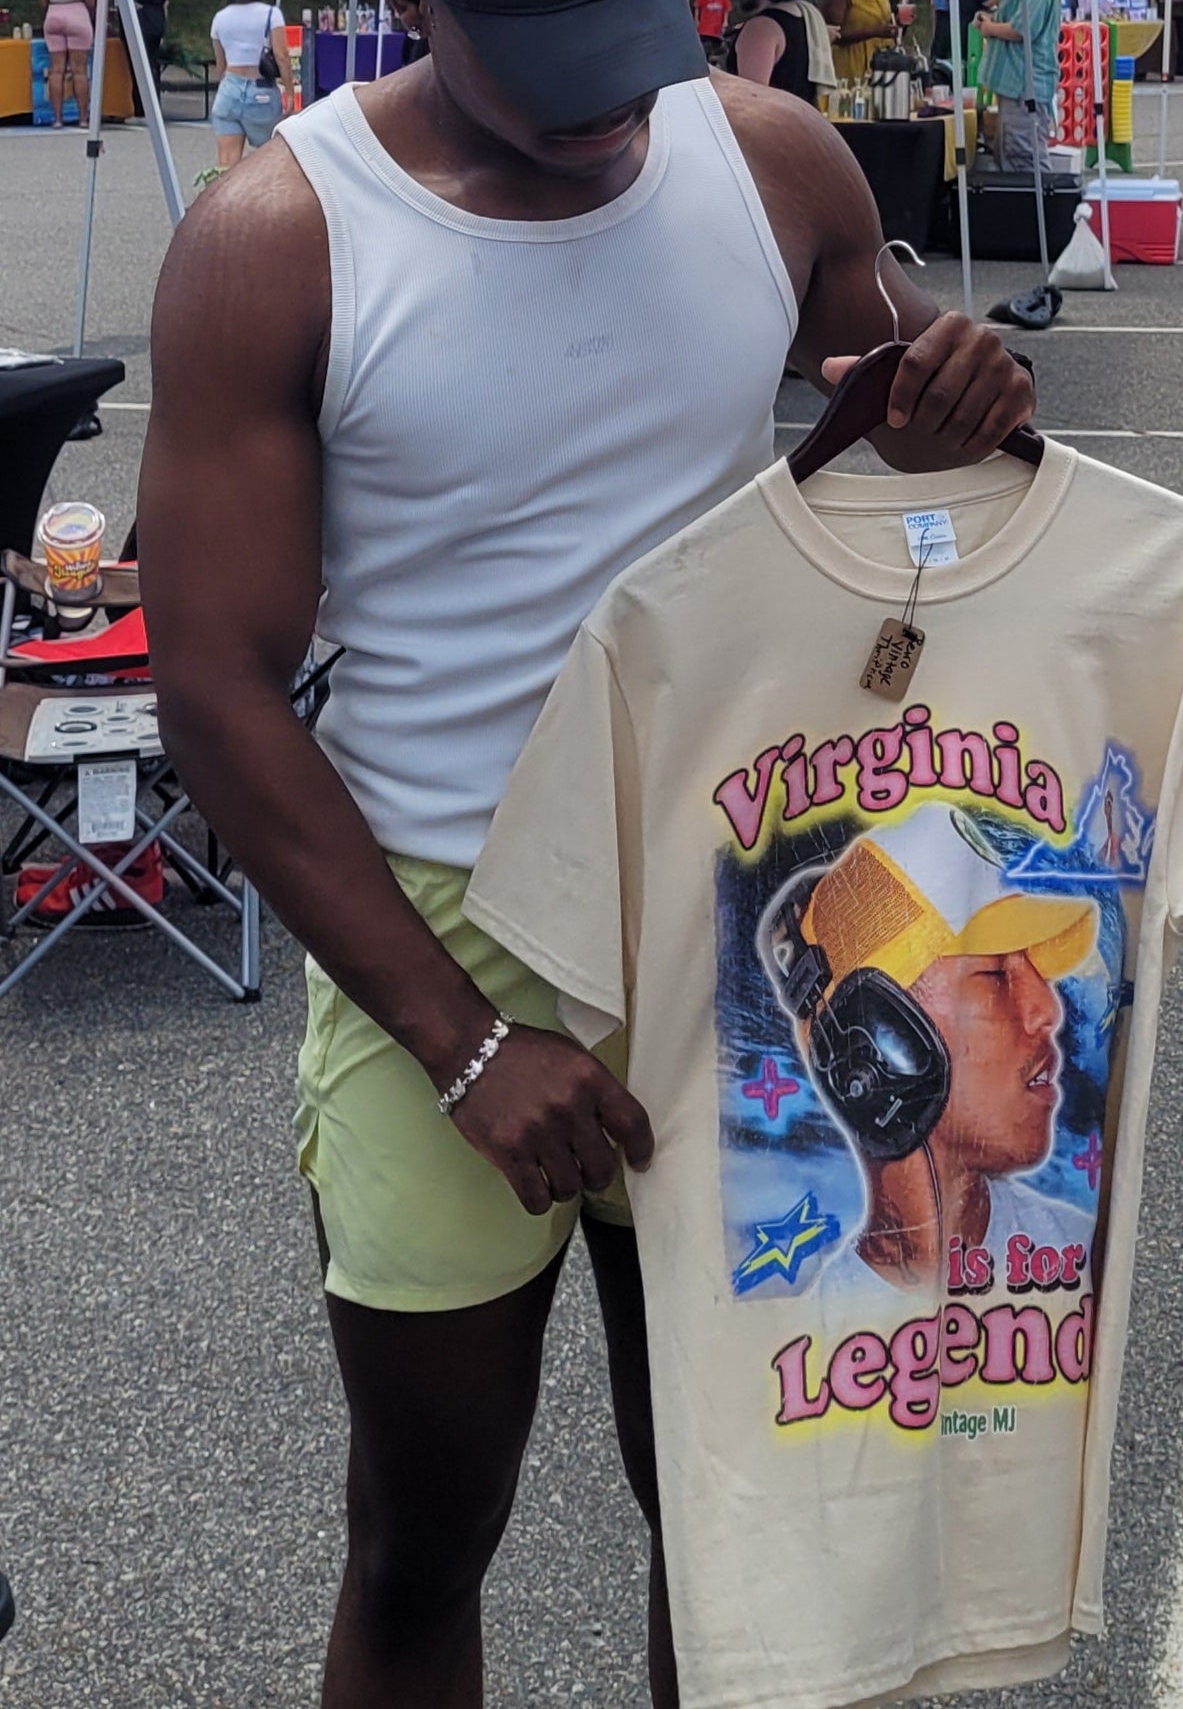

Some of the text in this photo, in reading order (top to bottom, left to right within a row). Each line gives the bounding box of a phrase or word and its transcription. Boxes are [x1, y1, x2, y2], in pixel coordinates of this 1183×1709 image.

[906, 513, 936, 525] PORT
[712, 703, 1067, 850] Virginia
[947, 1233, 1086, 1296] is for
[771, 1293, 1095, 1431] Legend
[992, 1406, 1016, 1433] MJ
